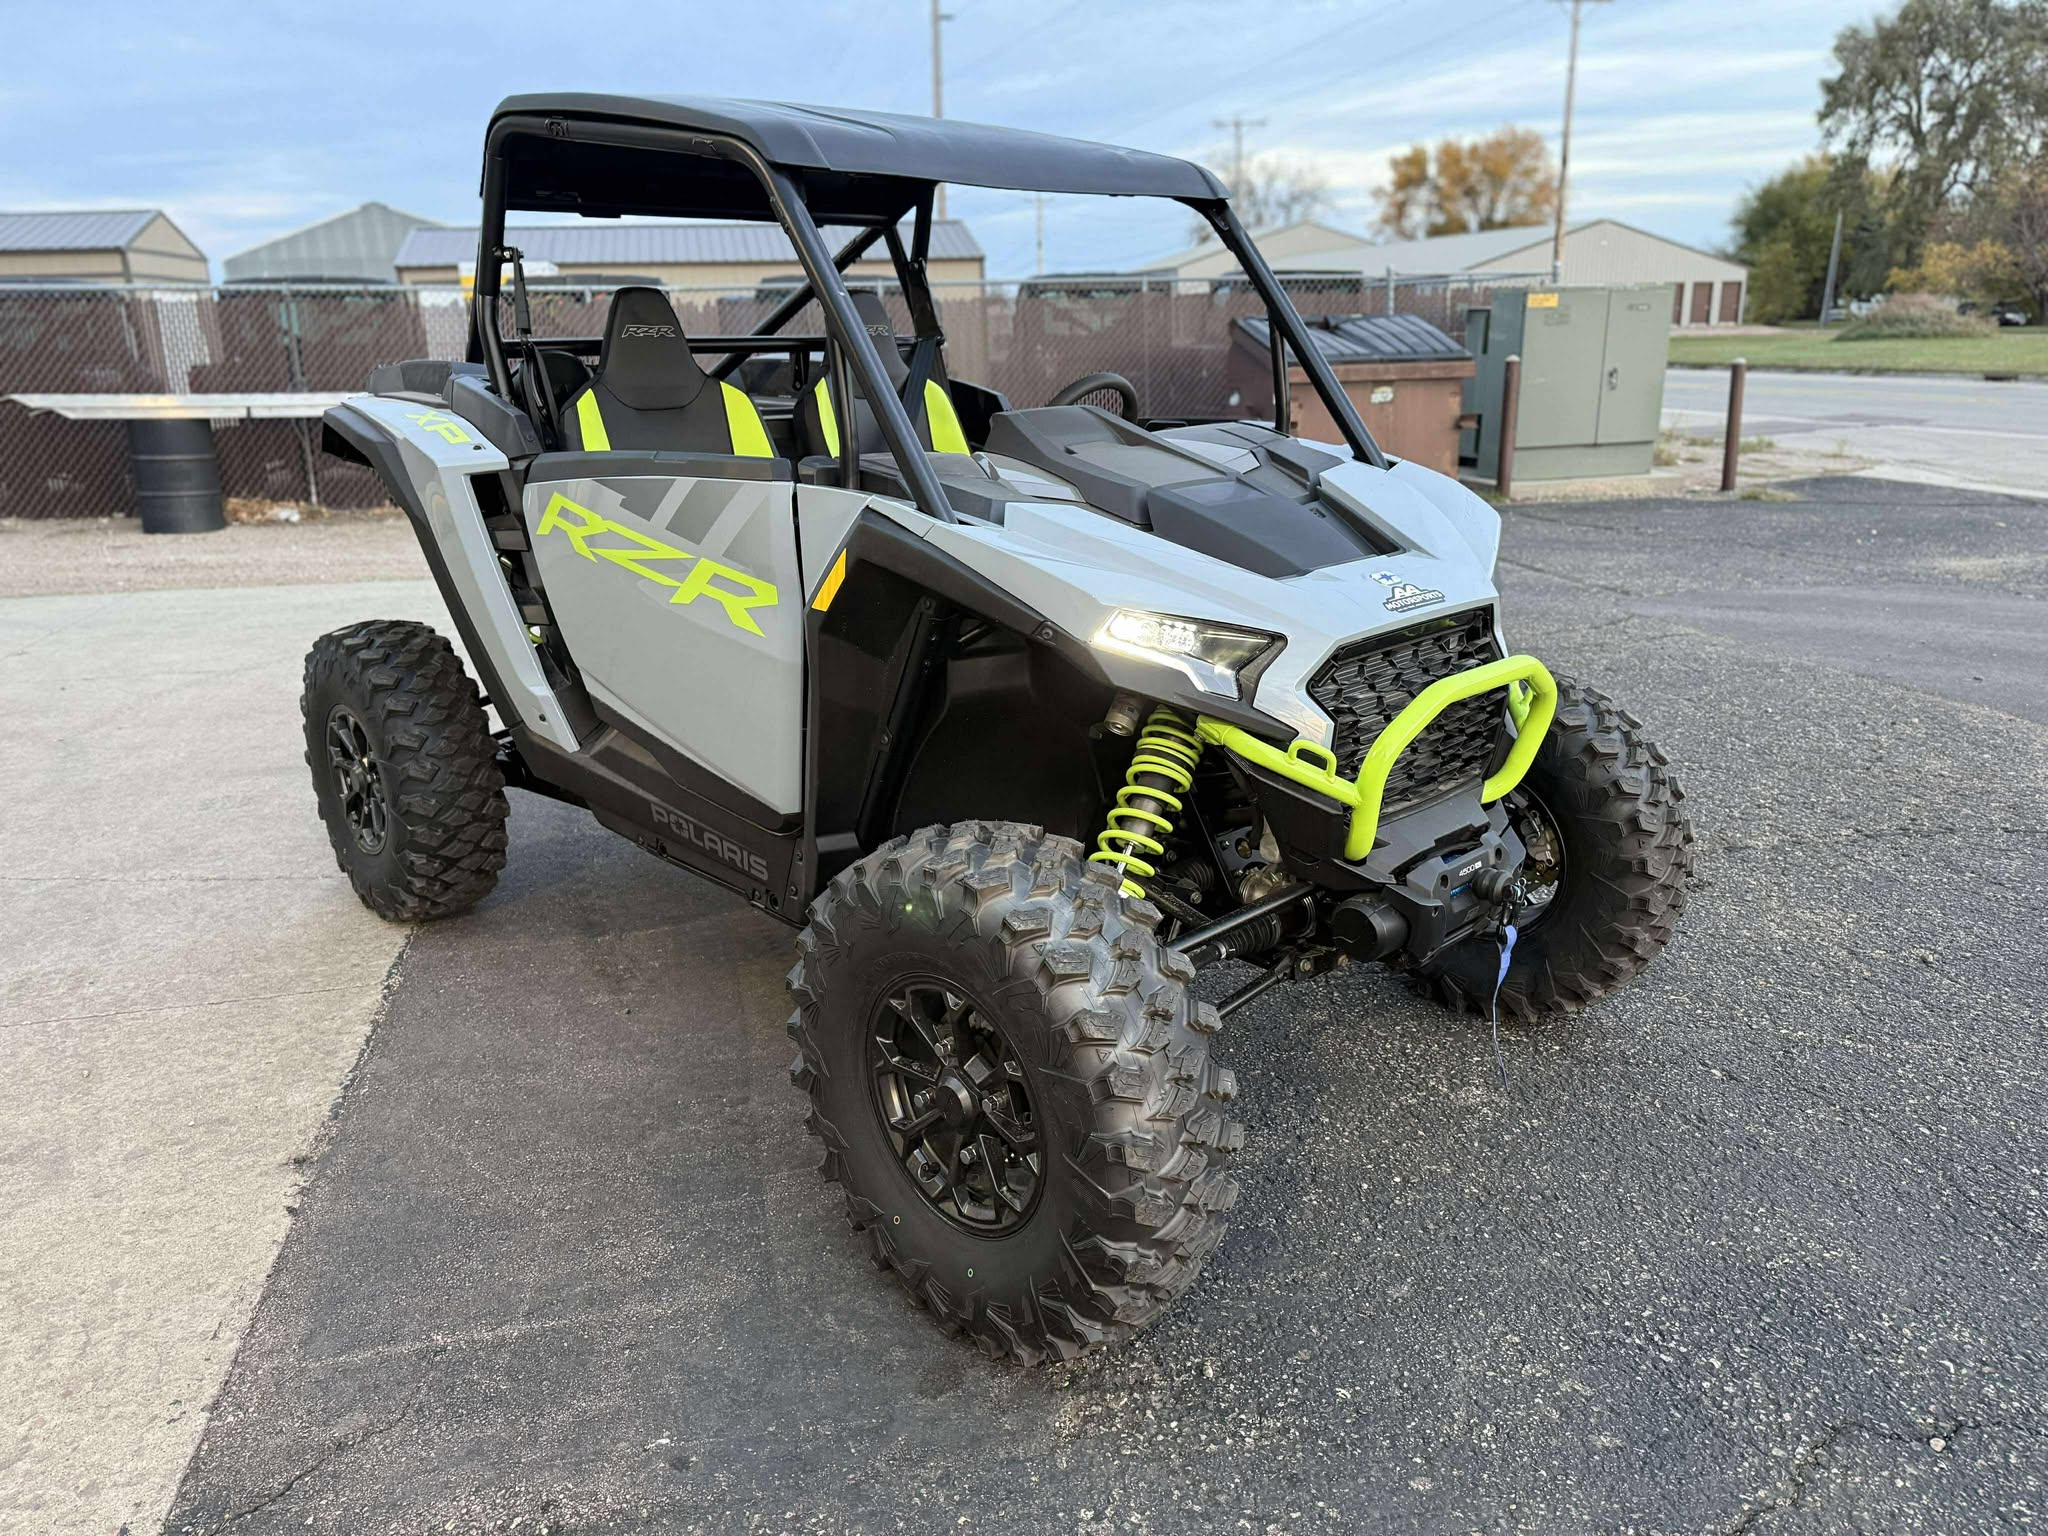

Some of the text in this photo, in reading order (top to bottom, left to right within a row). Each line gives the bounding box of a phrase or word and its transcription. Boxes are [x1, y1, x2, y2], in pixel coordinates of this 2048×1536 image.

[621, 324, 676, 338] RZR
[864, 324, 889, 336] ZR
[405, 410, 472, 444] XP
[536, 491, 779, 638] RZR
[1384, 590, 1443, 610] MOTORSPORTS
[1394, 584, 1421, 599] AA
[650, 802, 769, 881] POLARIS
[1458, 864, 1475, 877] 4500
